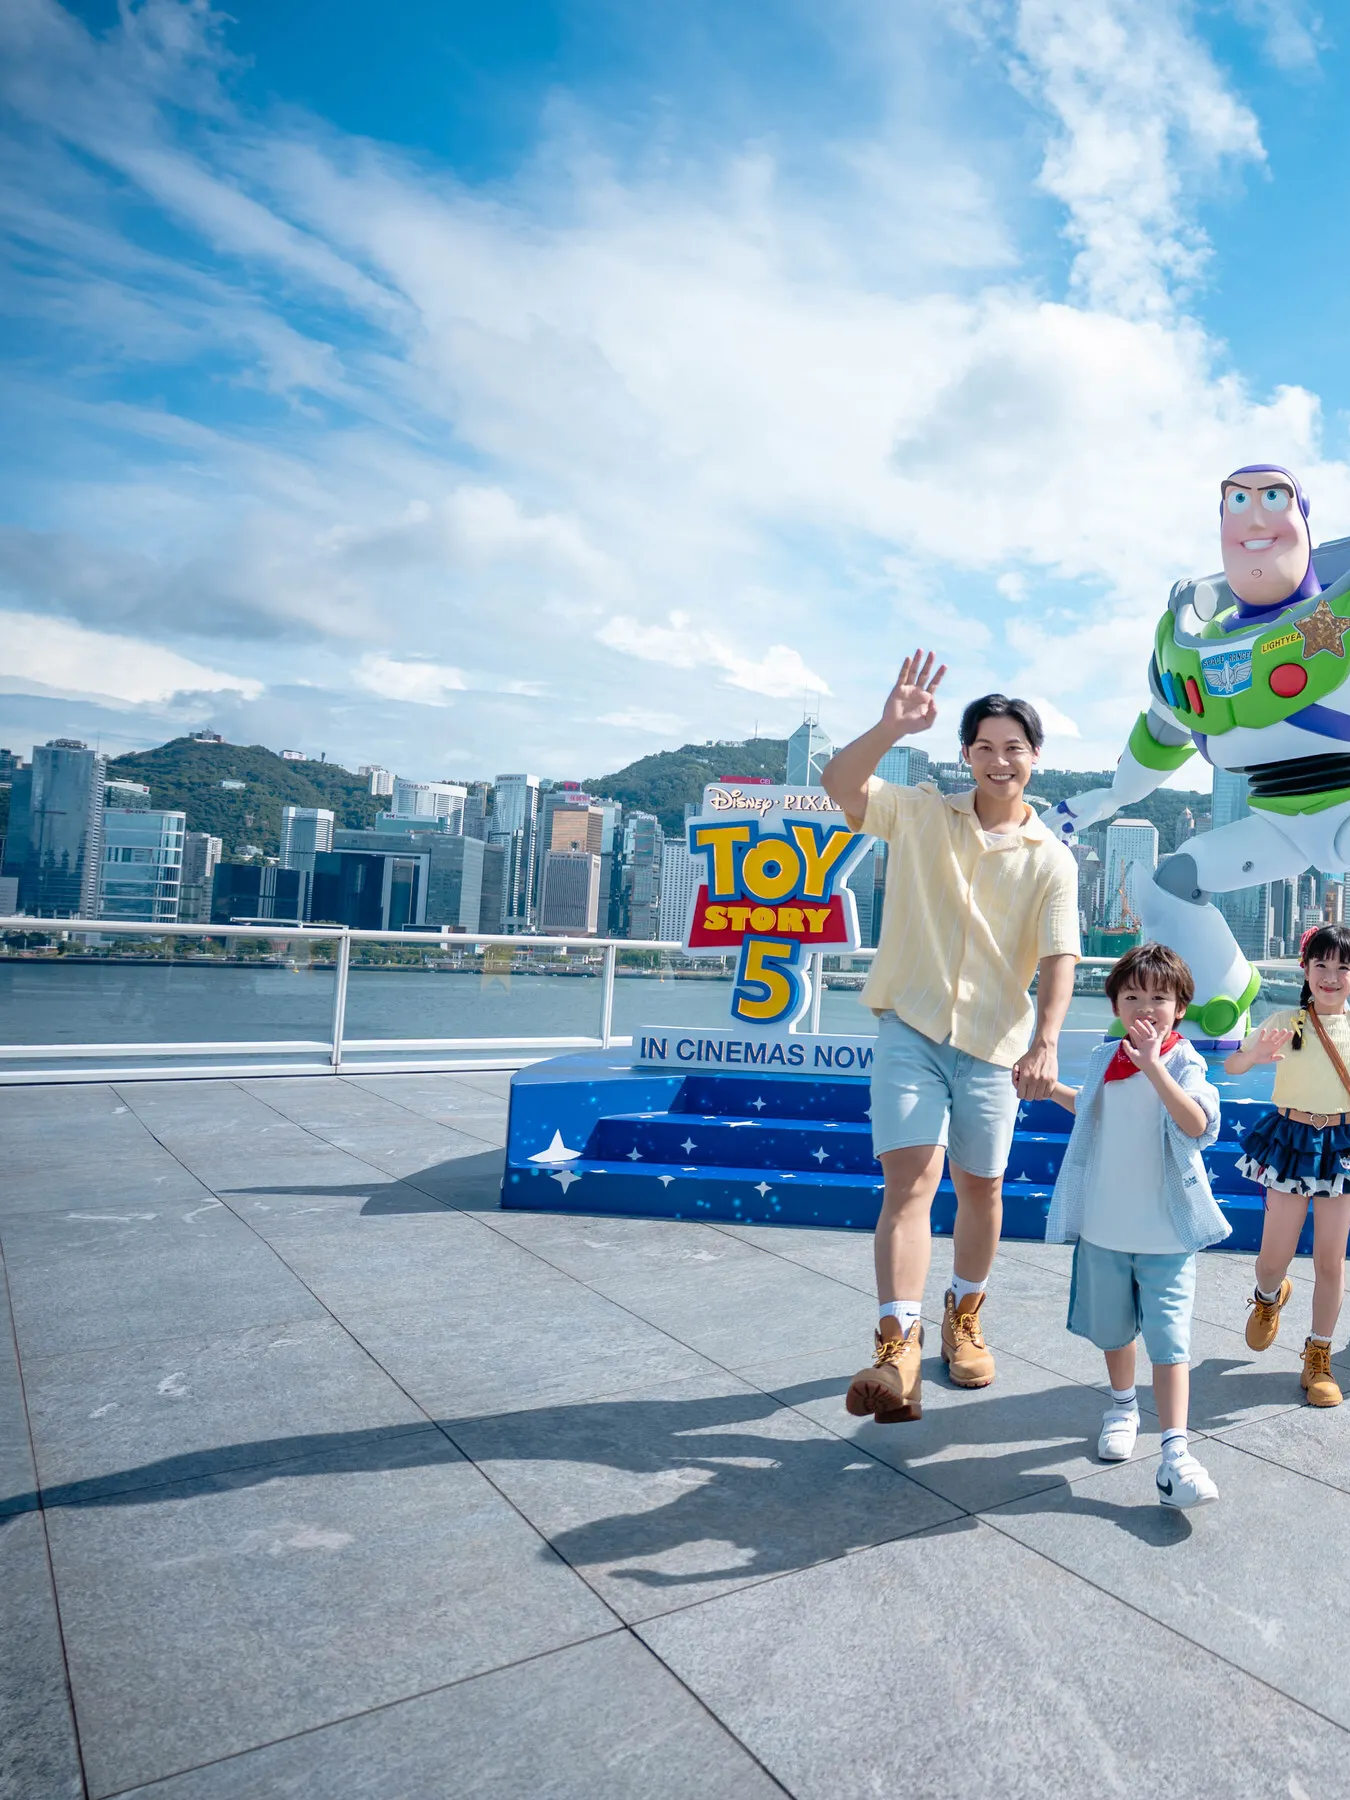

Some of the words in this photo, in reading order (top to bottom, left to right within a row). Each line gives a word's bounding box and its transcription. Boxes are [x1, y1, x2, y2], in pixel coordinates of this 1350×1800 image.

[1262, 633, 1304, 653] LIGHTYEA
[1203, 655, 1224, 667] SPACE
[707, 786, 774, 817] Disney
[783, 795, 843, 811] PIXA
[695, 825, 855, 900] TOY
[703, 904, 832, 933] STORY
[737, 939, 795, 1019] 5
[640, 1037, 668, 1060] IN
[676, 1038, 806, 1066] CINEMAS
